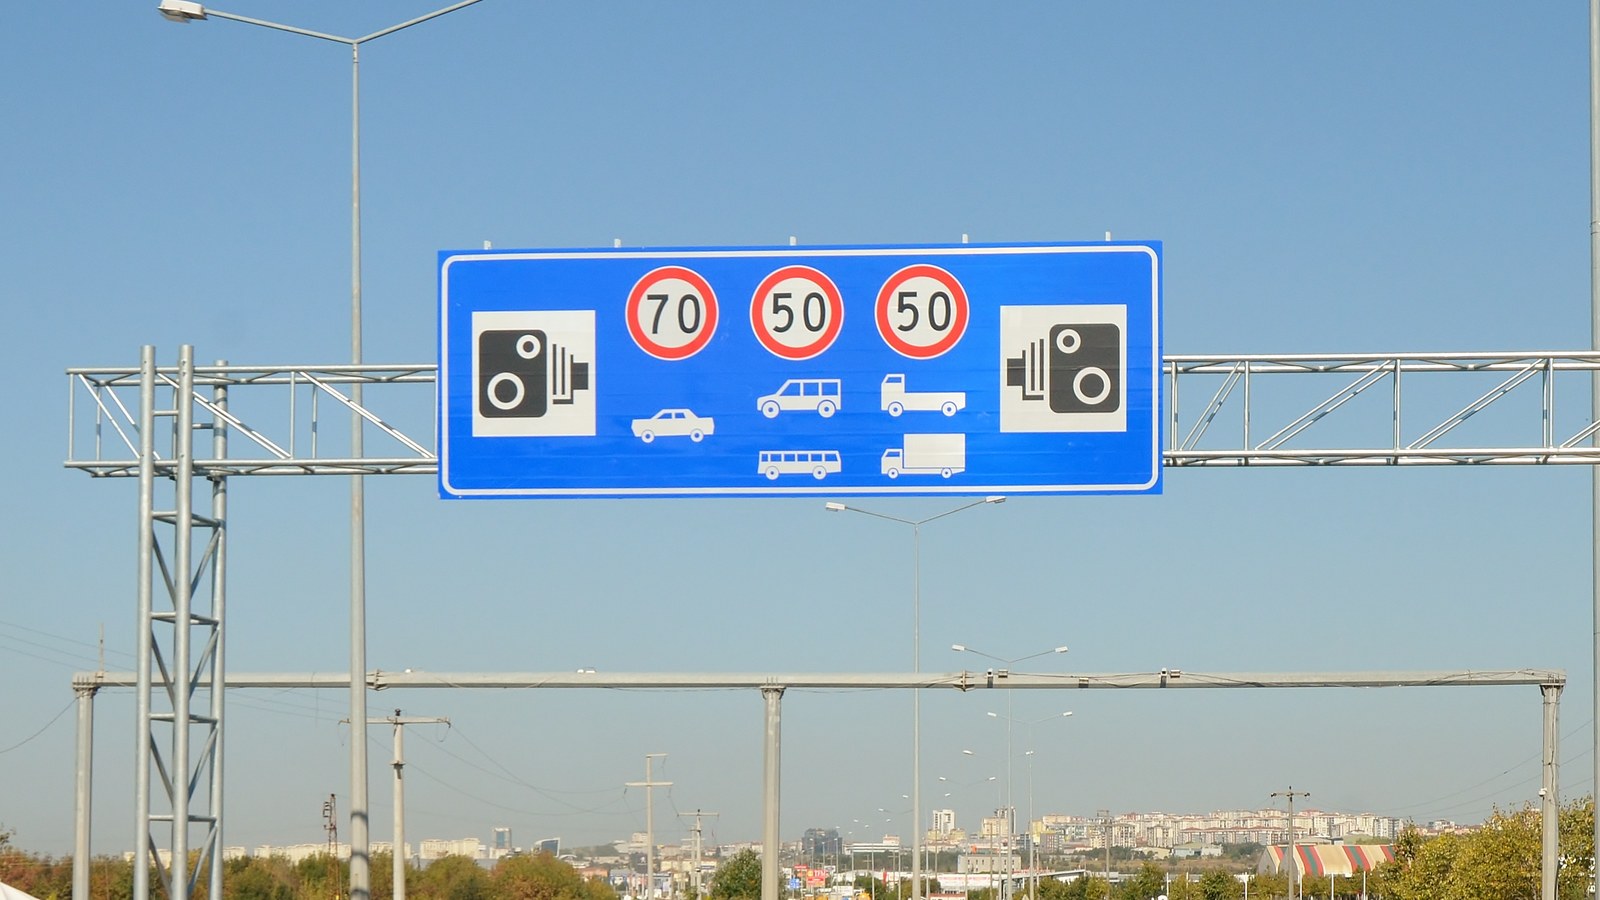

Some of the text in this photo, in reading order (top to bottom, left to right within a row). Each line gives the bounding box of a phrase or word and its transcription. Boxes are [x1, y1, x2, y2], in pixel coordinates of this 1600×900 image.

[647, 294, 701, 334] 70
[772, 292, 826, 333] 50
[897, 291, 951, 332] 50
